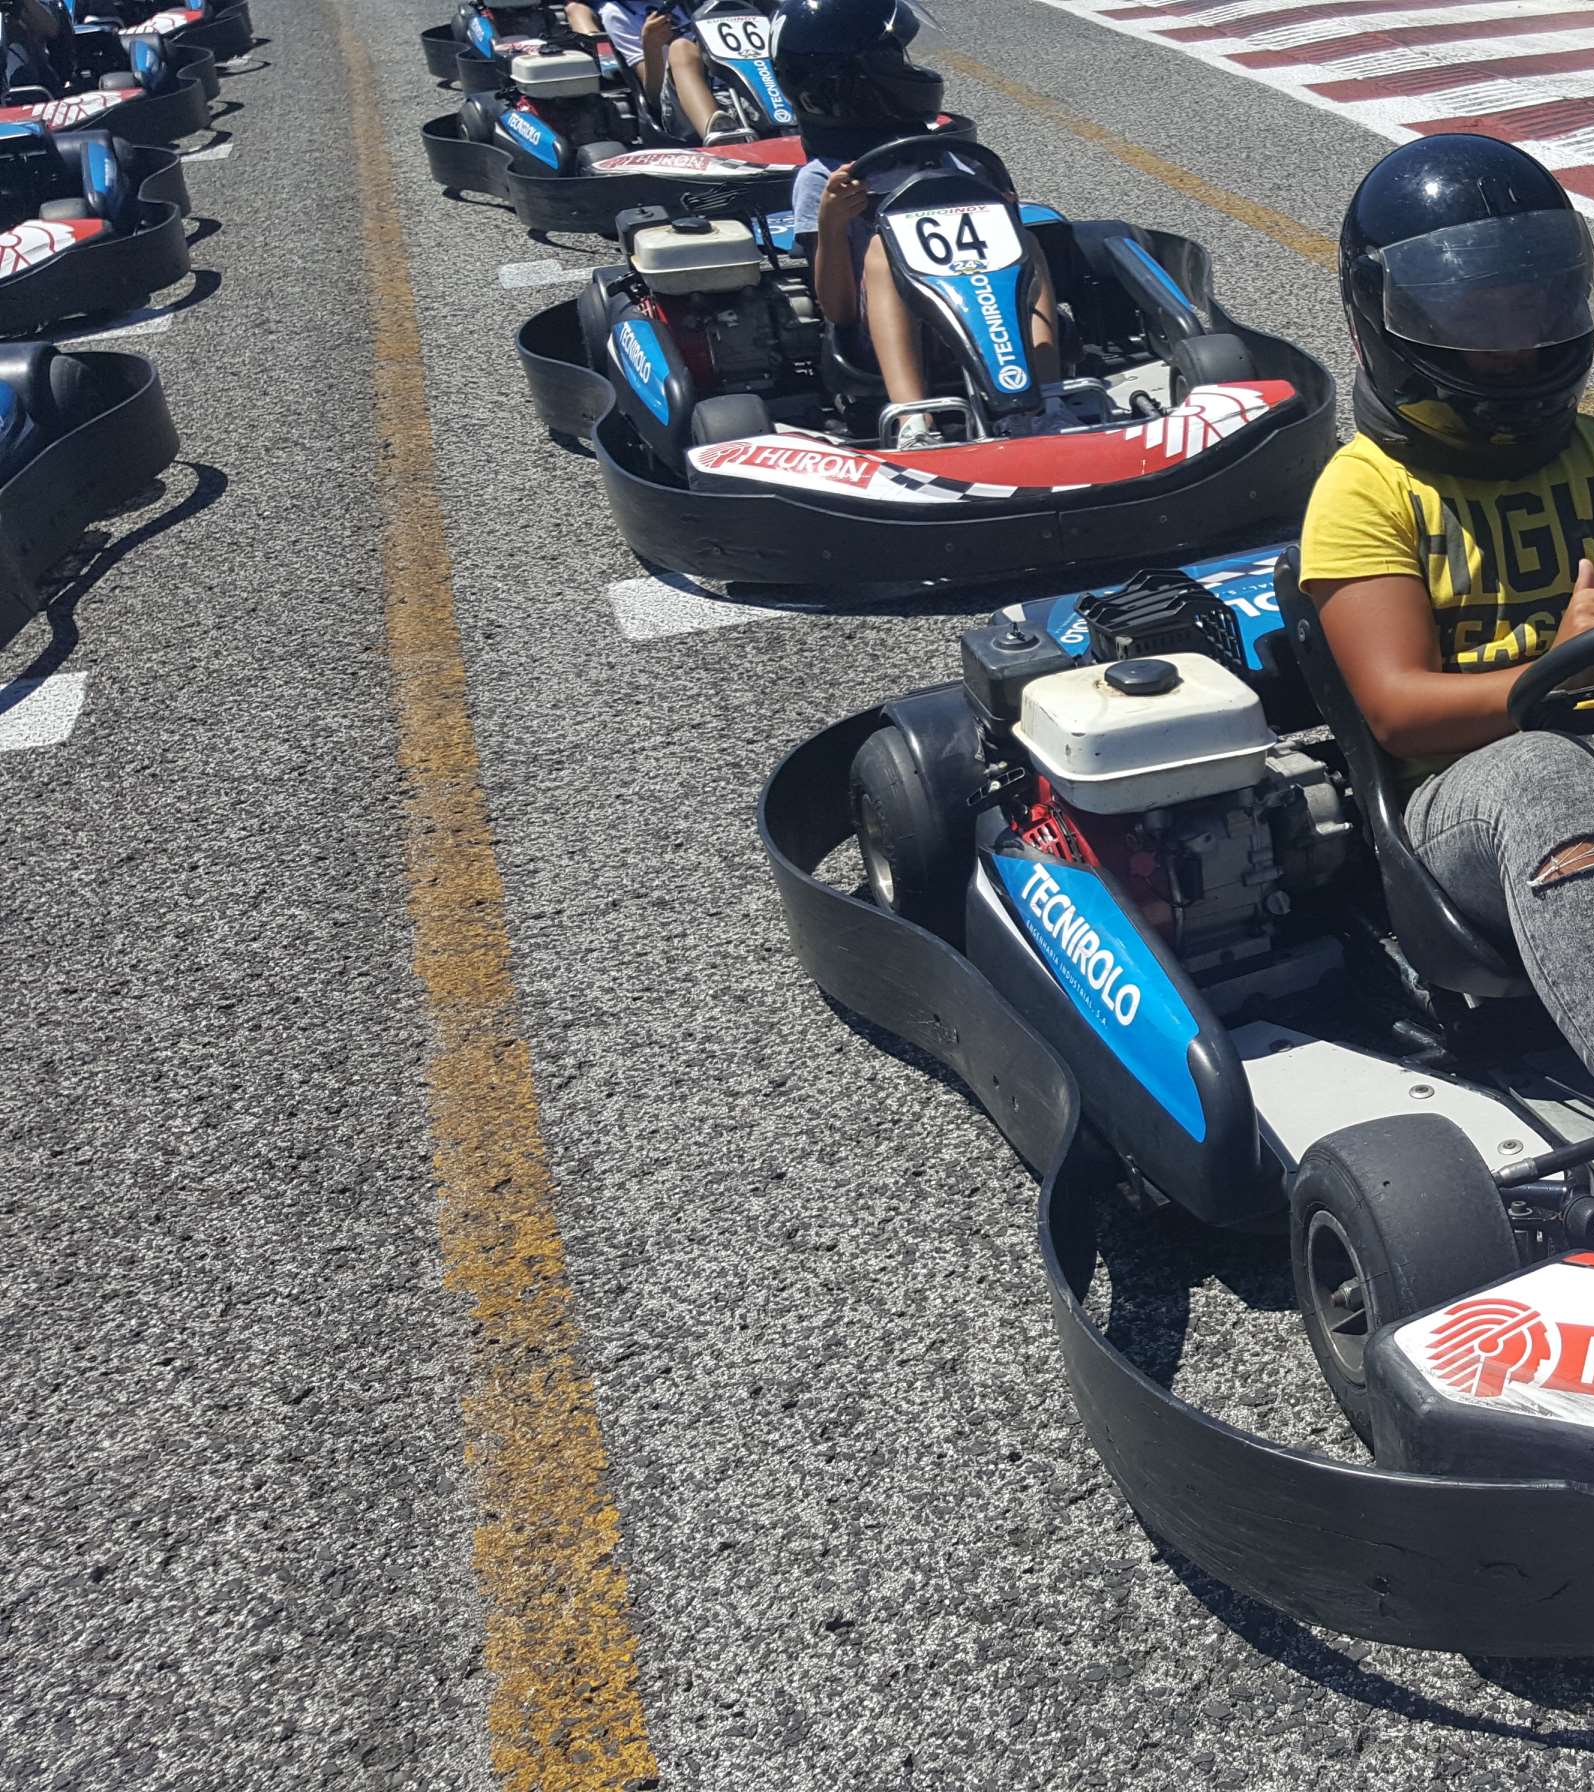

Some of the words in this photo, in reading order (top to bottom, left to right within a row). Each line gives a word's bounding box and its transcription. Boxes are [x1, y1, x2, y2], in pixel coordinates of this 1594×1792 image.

[717, 21, 765, 52] 66
[915, 212, 988, 266] 64
[970, 273, 1016, 365] TECNIROLO
[756, 448, 869, 482] HURON
[1020, 862, 1141, 1026] TECNIROLO
